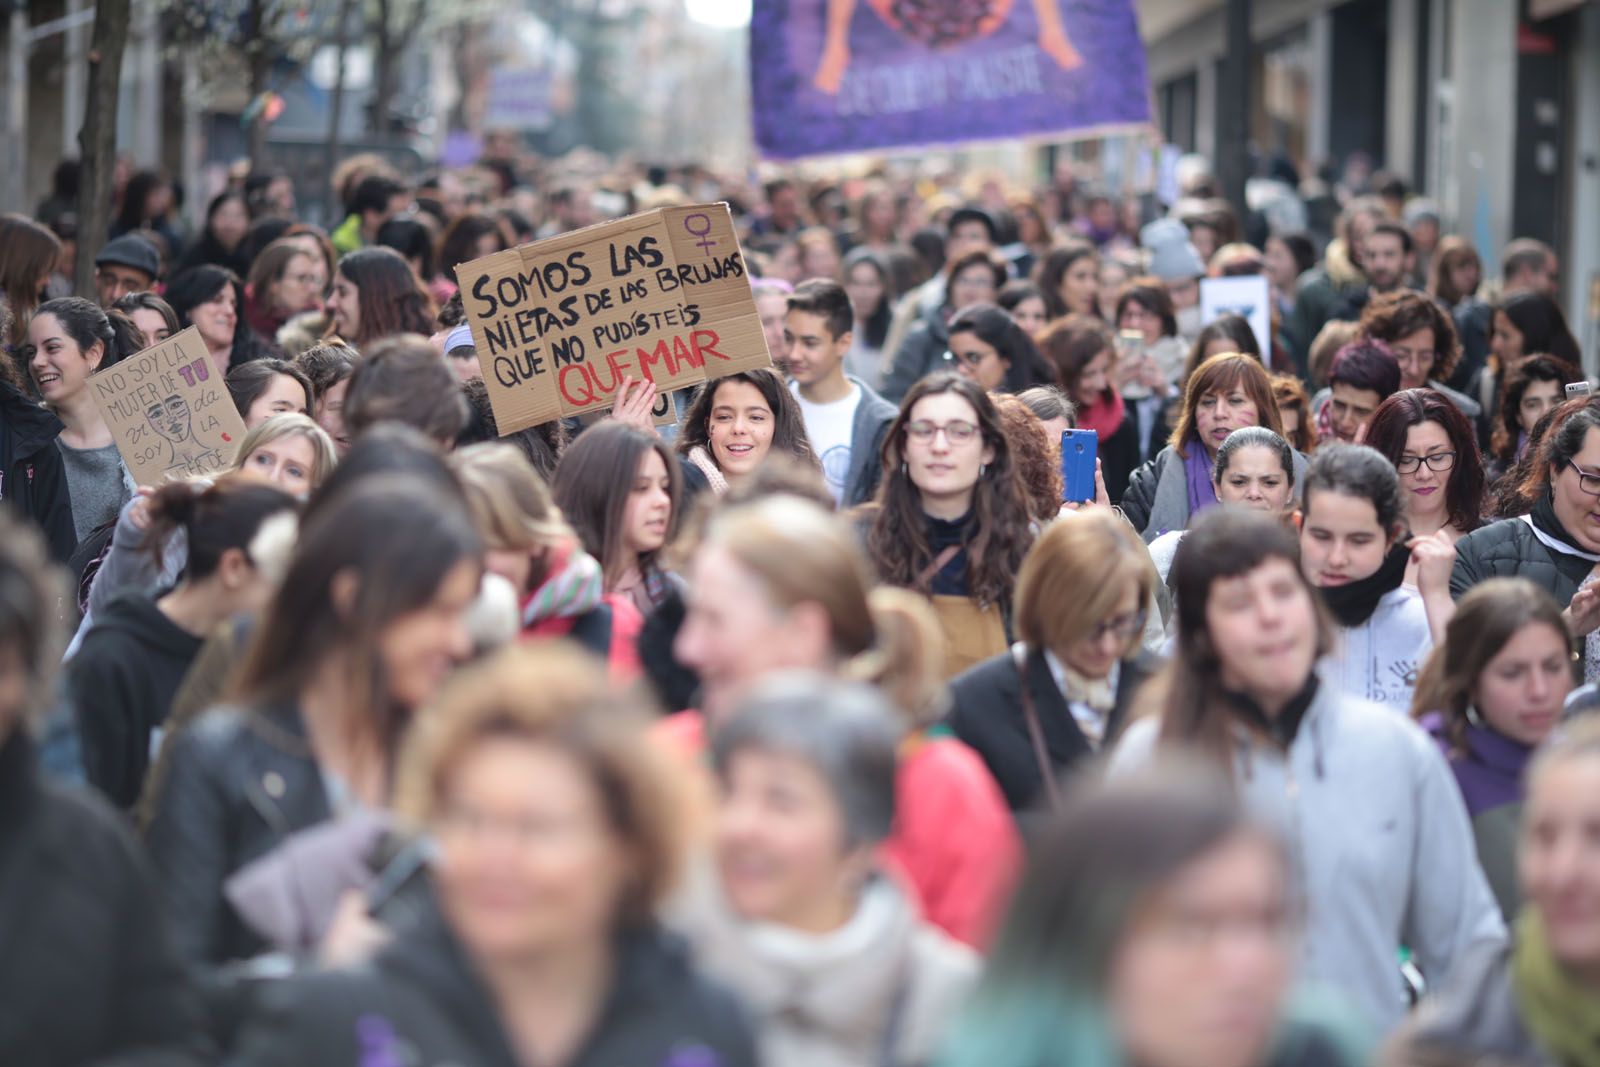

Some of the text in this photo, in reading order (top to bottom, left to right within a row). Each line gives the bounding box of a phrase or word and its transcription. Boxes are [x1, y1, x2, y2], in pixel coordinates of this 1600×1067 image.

[472, 236, 664, 319] SOMOS LAS
[584, 288, 613, 316] DE
[620, 278, 648, 304] LAS
[656, 252, 743, 292] BRUJAS
[96, 342, 188, 399] NO SOY LA
[107, 357, 209, 423] MUJER DE TU
[494, 347, 546, 388] QUE
[552, 335, 585, 368] NO
[558, 329, 731, 406] QUEMAR
[194, 389, 219, 412] da
[135, 415, 220, 465] SOY LA
[207, 449, 226, 469] DE
